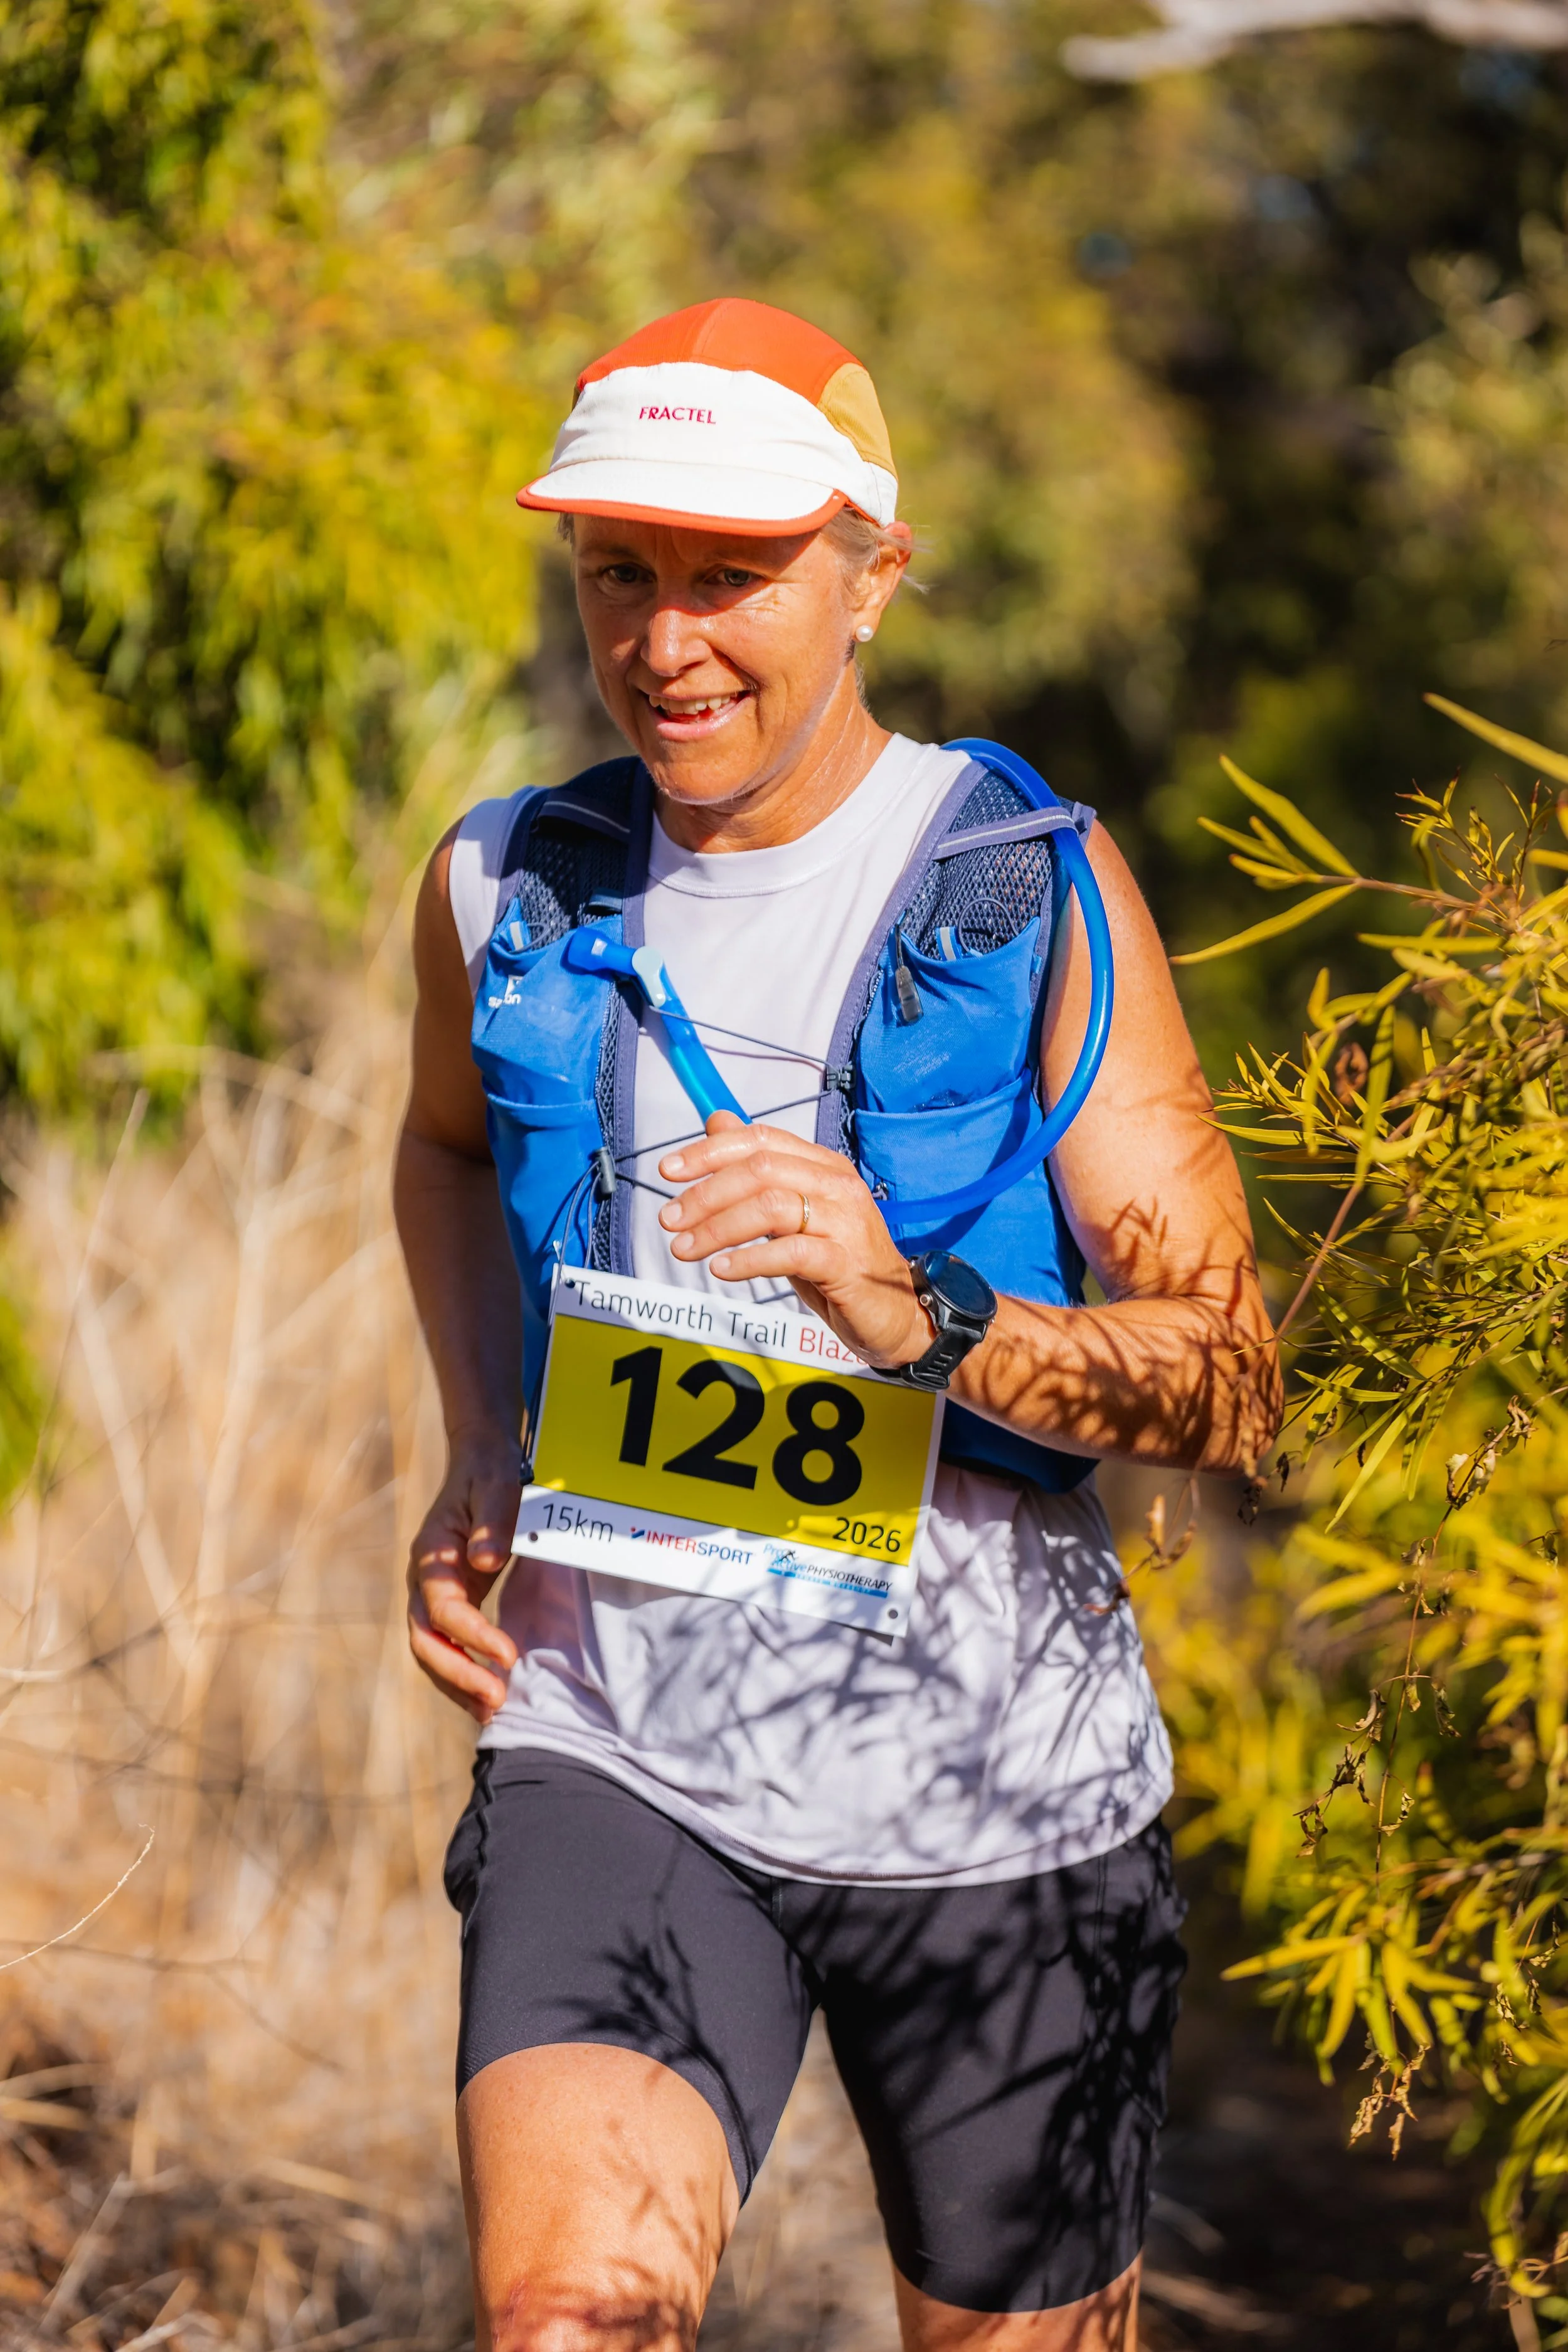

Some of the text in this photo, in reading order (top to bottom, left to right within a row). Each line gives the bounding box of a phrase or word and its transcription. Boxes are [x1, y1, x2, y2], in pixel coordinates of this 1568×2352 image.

[638, 406, 716, 425] FRACTEL
[575, 1279, 713, 1332] Tamworth
[728, 1310, 787, 1348] Trail
[610, 1345, 865, 1506] 128
[543, 1503, 613, 1542] 15km
[832, 1517, 901, 1552] 2026
[645, 1530, 754, 1565] INTERSPORT
[807, 1564, 893, 1591] PHYSIOTHERAPY
